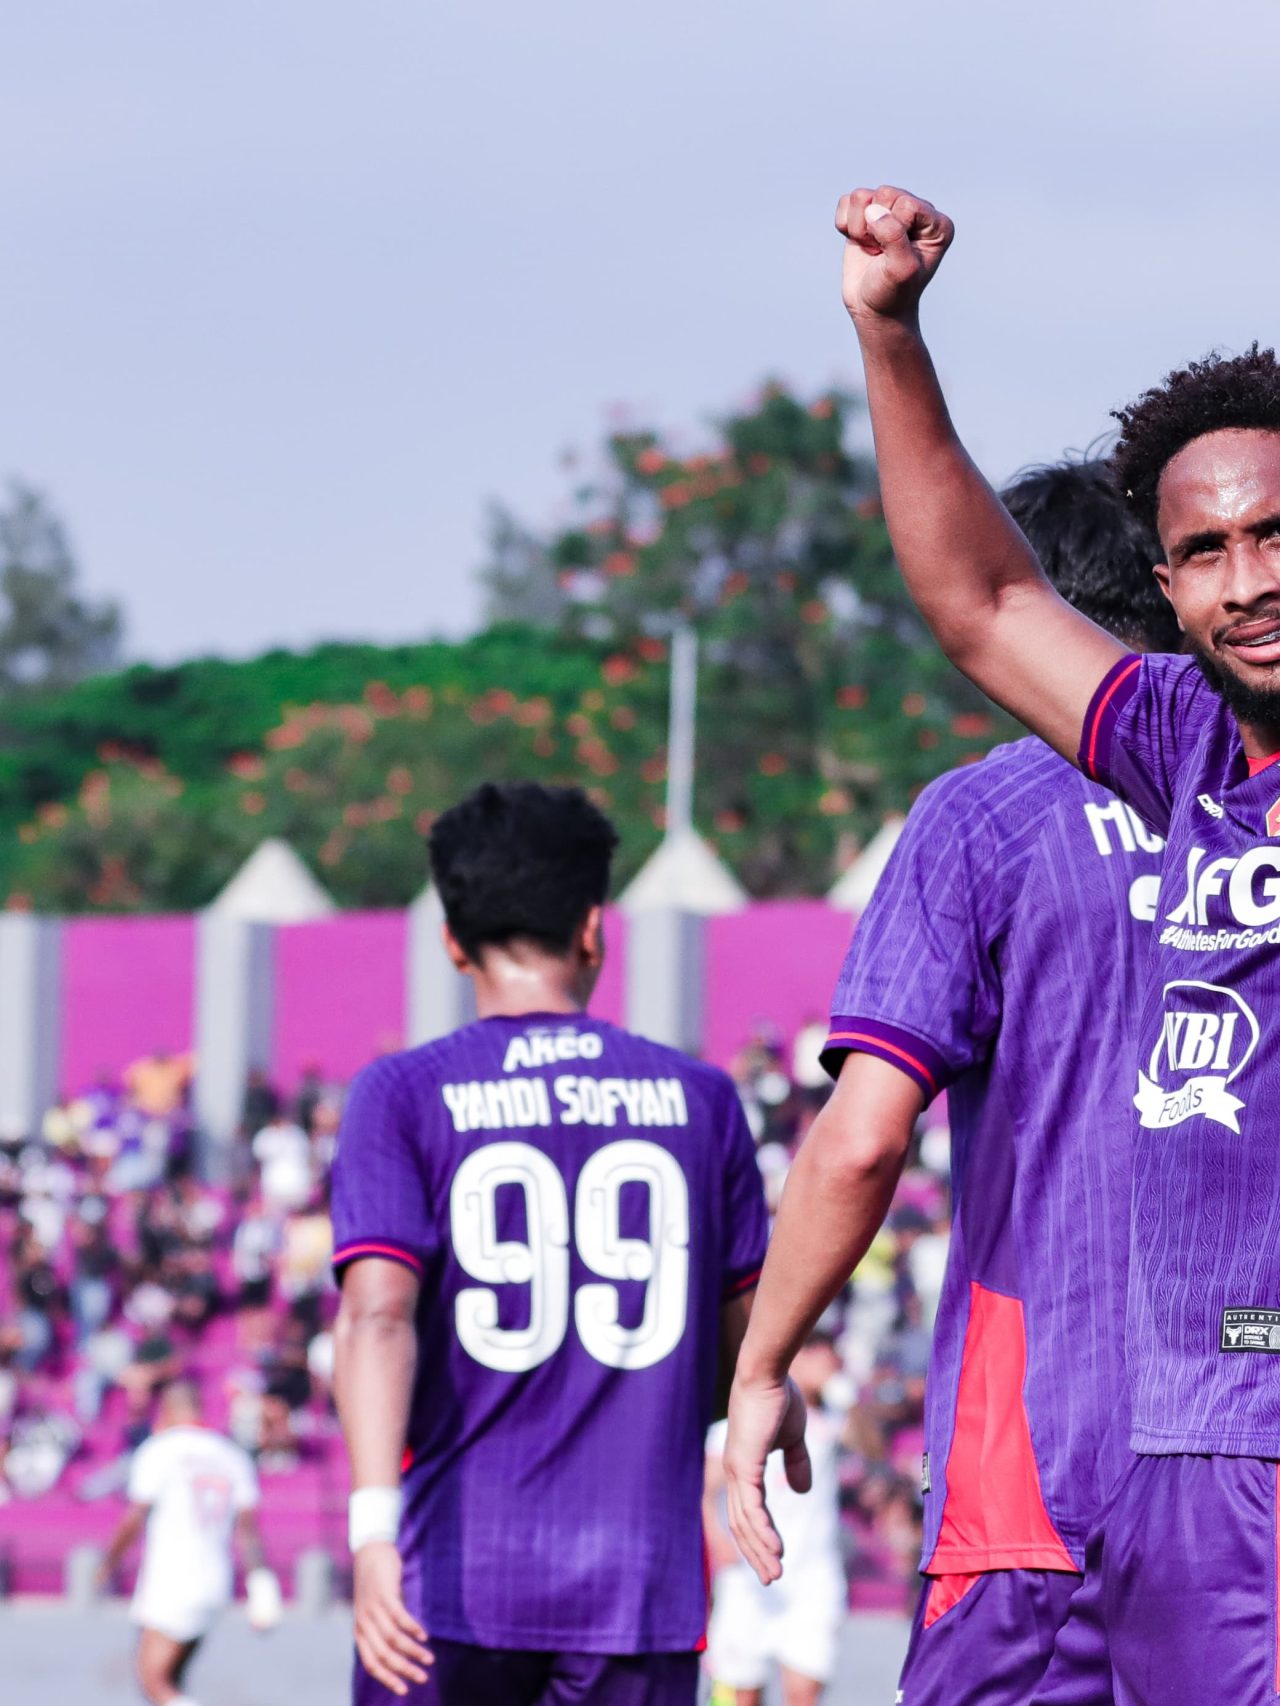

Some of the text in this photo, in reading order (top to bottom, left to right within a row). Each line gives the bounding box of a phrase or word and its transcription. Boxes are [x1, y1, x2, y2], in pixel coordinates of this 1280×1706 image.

[442, 1075, 689, 1132] YANDI SOFYAN
[1158, 1084, 1204, 1123] Foods
[450, 1139, 690, 1373] 99
[1244, 1326, 1269, 1335] DRX
